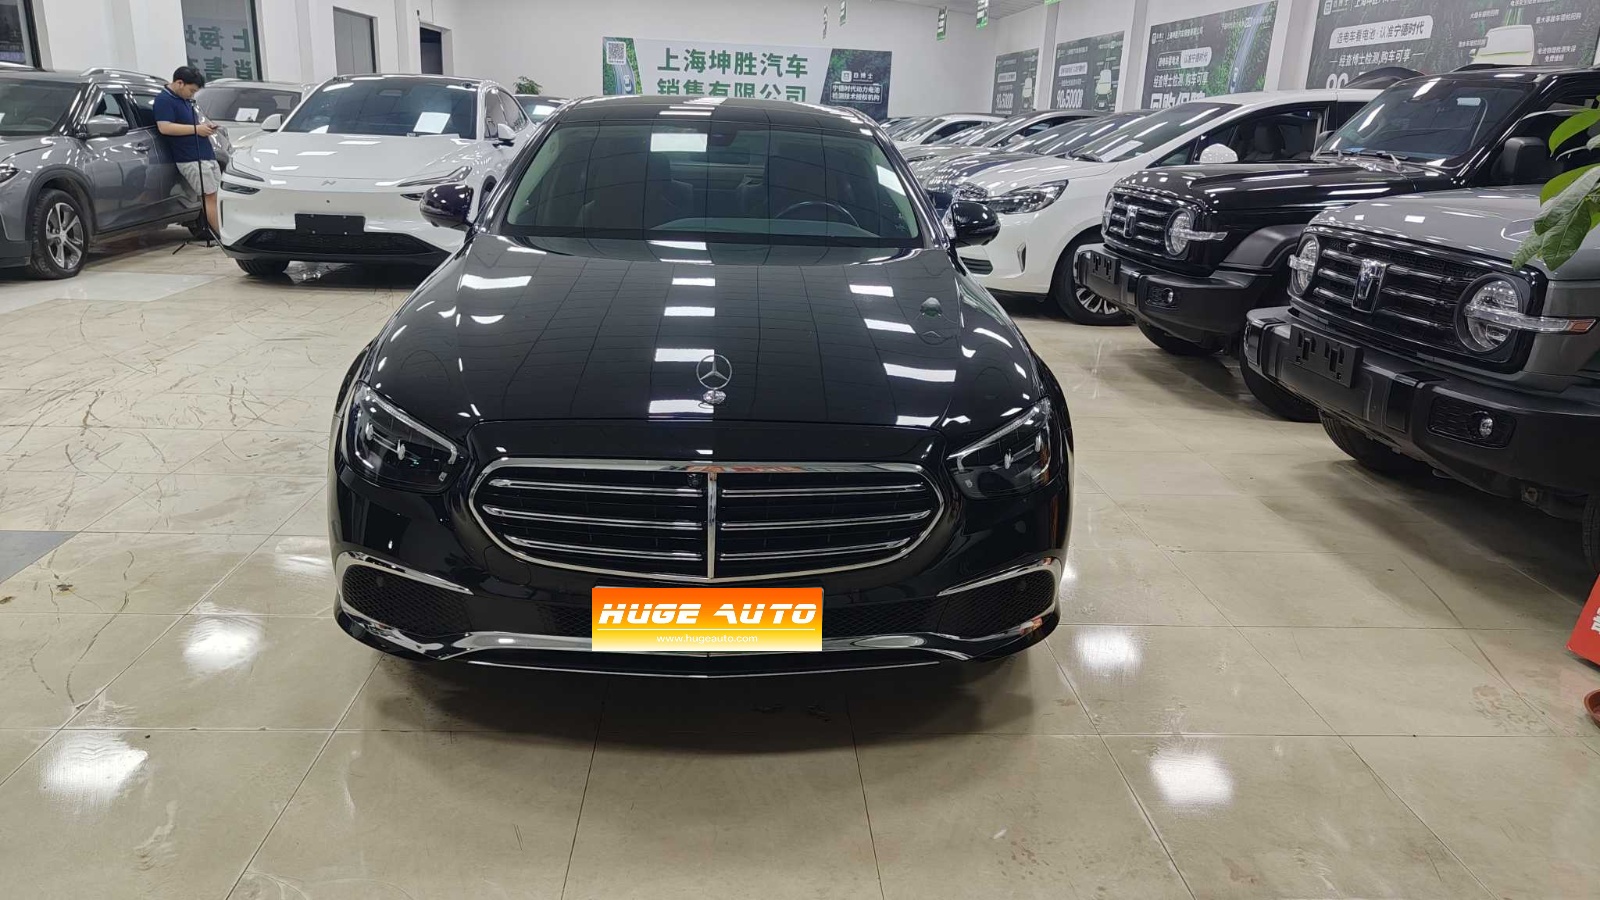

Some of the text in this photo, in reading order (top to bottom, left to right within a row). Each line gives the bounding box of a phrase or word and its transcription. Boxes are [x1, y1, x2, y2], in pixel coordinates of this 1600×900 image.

[657, 47, 808, 79] 上海坤胜汽车
[657, 78, 807, 102] 销售有限公司
